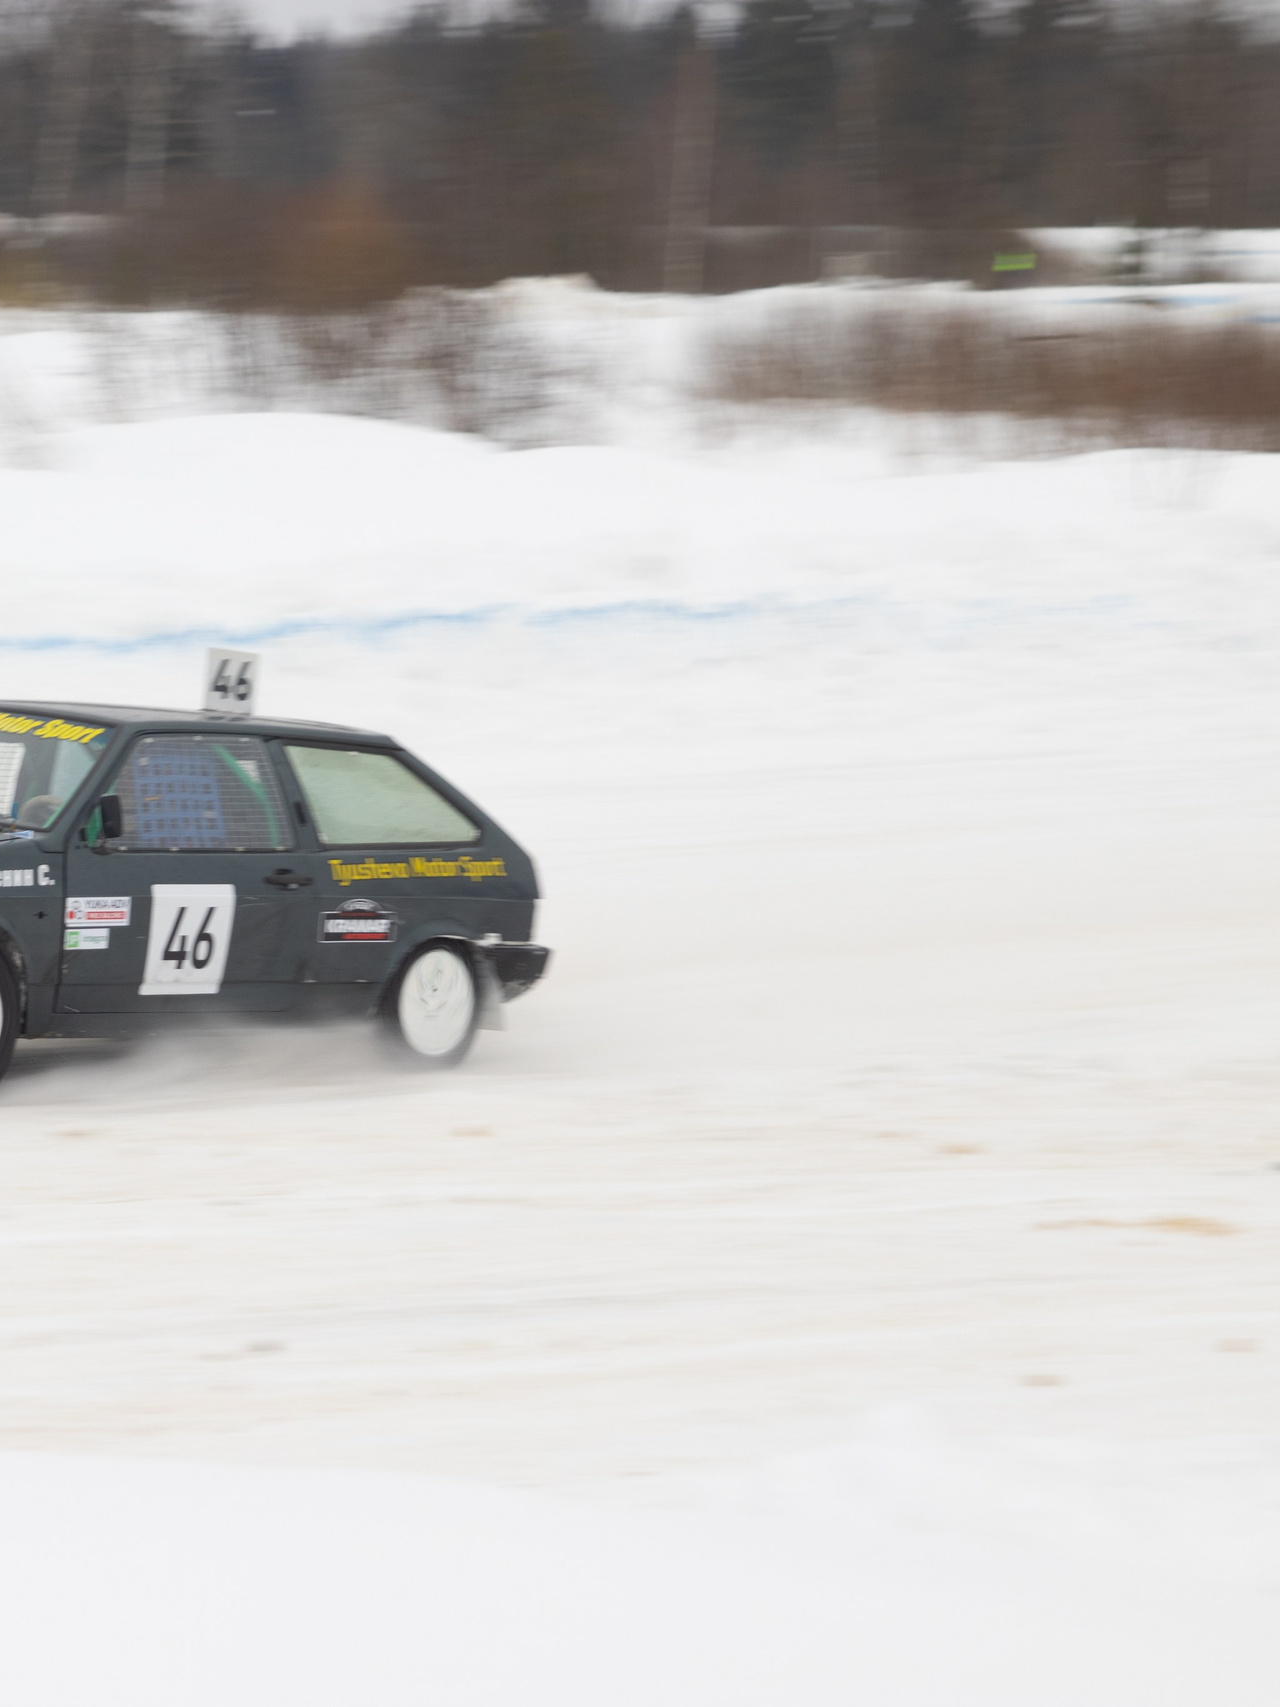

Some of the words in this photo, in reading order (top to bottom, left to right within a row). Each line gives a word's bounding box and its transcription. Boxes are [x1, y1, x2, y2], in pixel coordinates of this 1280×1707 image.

[209, 658, 254, 701] 46
[32, 719, 106, 744] Sport
[408, 857, 458, 877] Motor
[457, 856, 507, 882] Sport
[161, 906, 217, 969] 46
